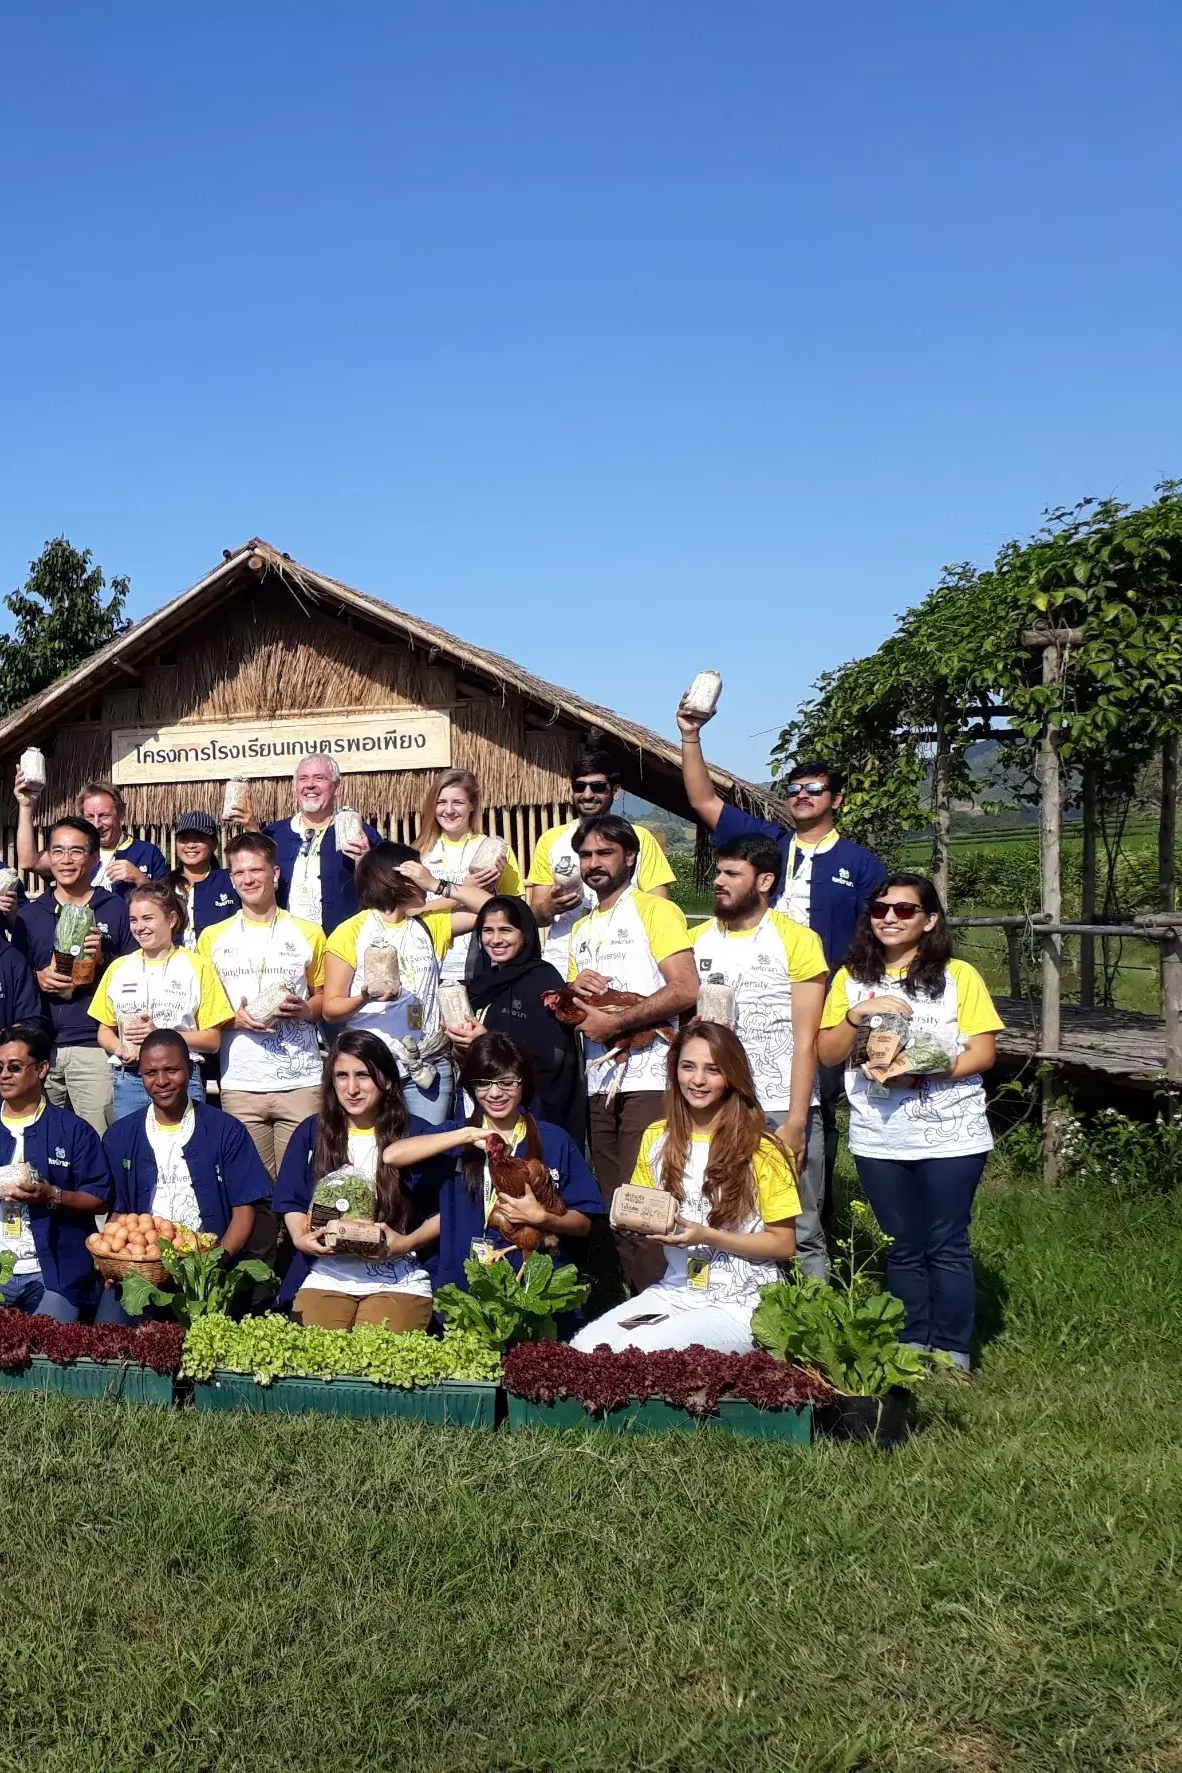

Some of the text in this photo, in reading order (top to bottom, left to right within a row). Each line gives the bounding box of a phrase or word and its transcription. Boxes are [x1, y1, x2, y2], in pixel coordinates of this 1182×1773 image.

[135, 730, 426, 764] โครงการโรงเรียนเกษตรพอเพียง
